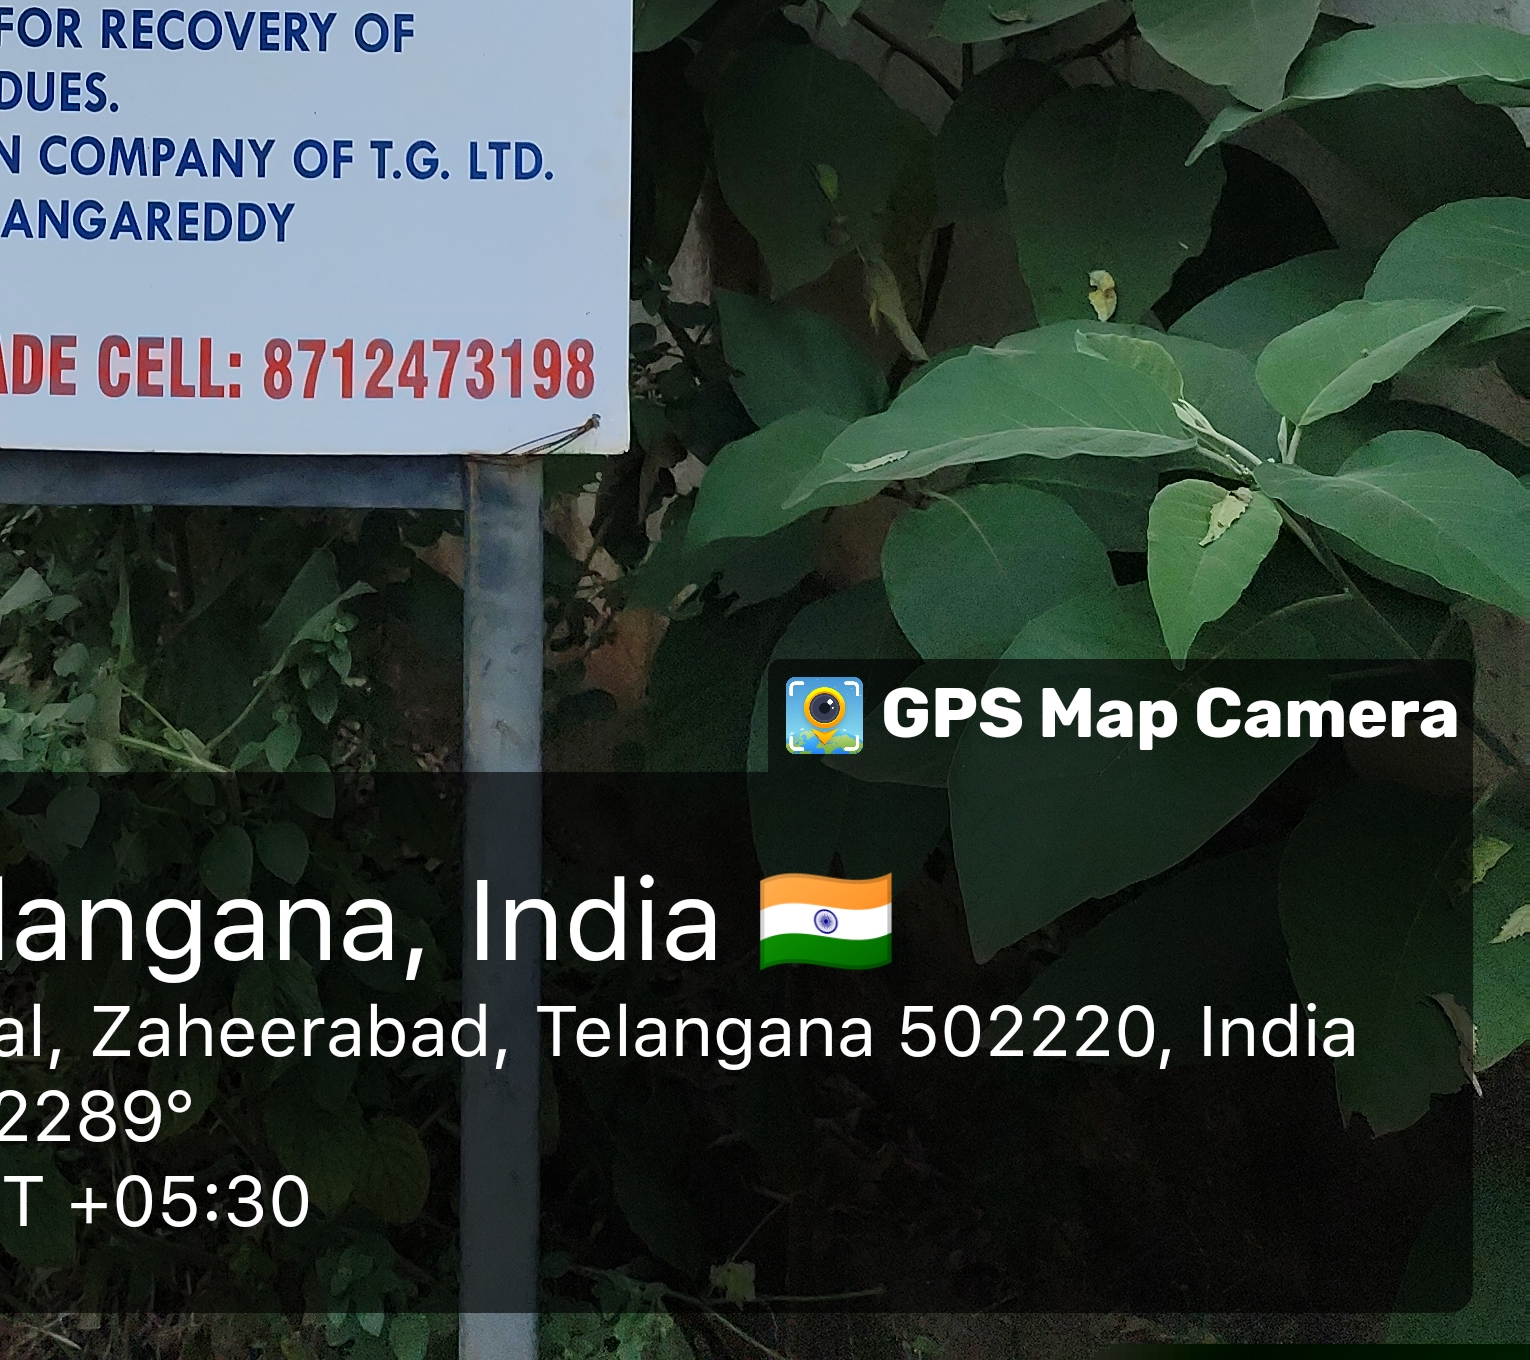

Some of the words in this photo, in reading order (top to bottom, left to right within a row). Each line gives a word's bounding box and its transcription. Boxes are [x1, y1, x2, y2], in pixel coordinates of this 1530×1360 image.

[101, 9, 337, 52] RECOVERY
[355, 13, 415, 52] OF
[39, 135, 275, 178] COMPANY
[293, 139, 353, 179] OF
[370, 140, 449, 180] T.G.
[469, 142, 553, 181] LTD.
[98, 335, 241, 399] CELL:
[264, 338, 595, 400] 8712473198
